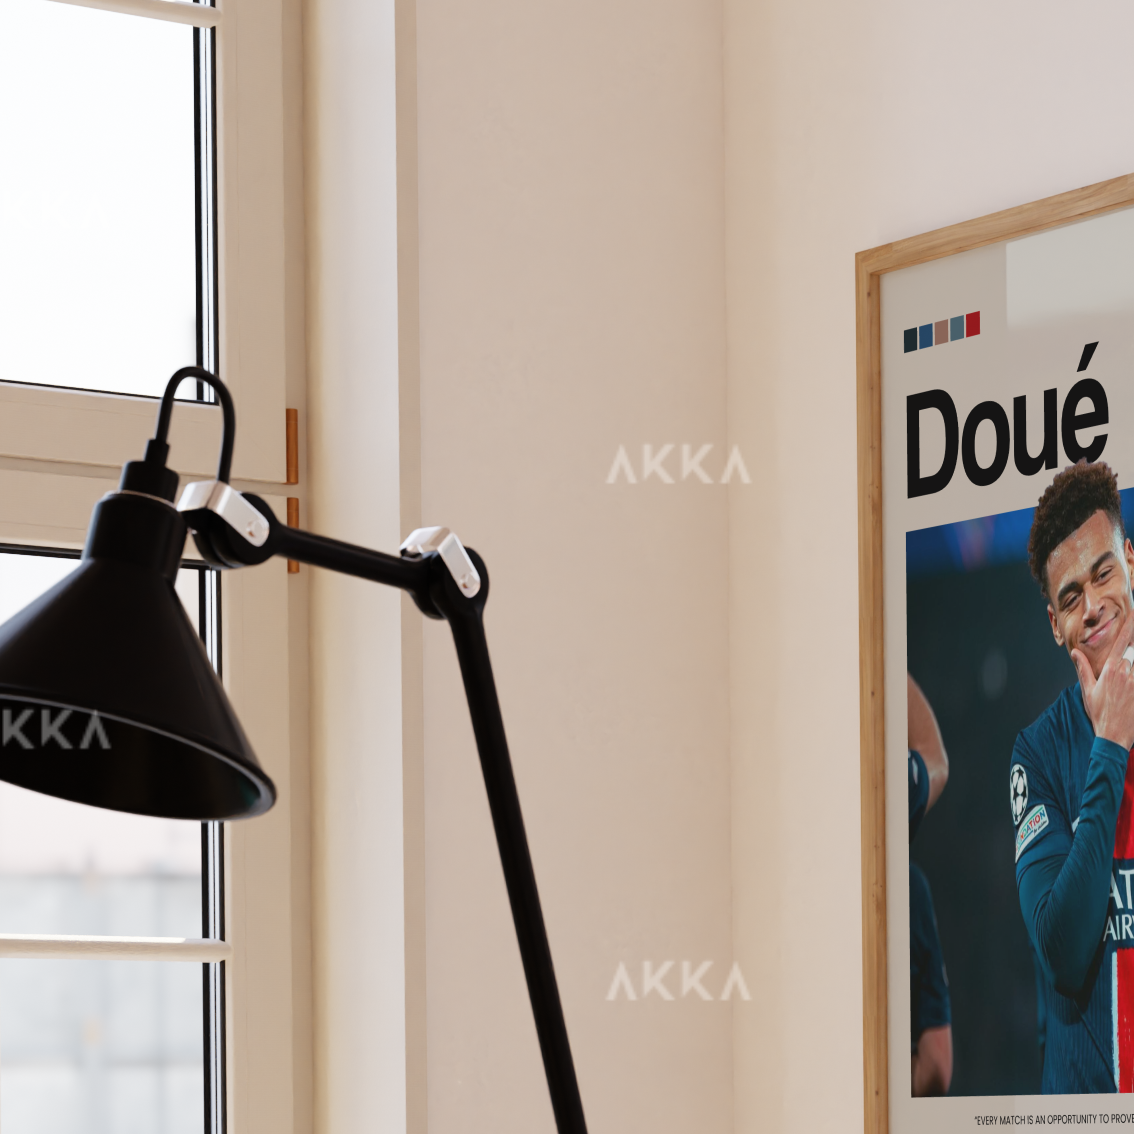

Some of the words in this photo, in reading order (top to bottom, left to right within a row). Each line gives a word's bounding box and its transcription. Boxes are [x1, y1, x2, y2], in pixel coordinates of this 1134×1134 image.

[906, 341, 1109, 499] Doué
[1000, 1115, 1025, 1125] MATCH
[1027, 1115, 1033, 1125] IS
[1036, 1115, 1046, 1124] AN
[1047, 1114, 1097, 1125] OPPORTUNITY
[1099, 1114, 1109, 1124] TO
[1111, 1113, 1134, 1124] PROVE
